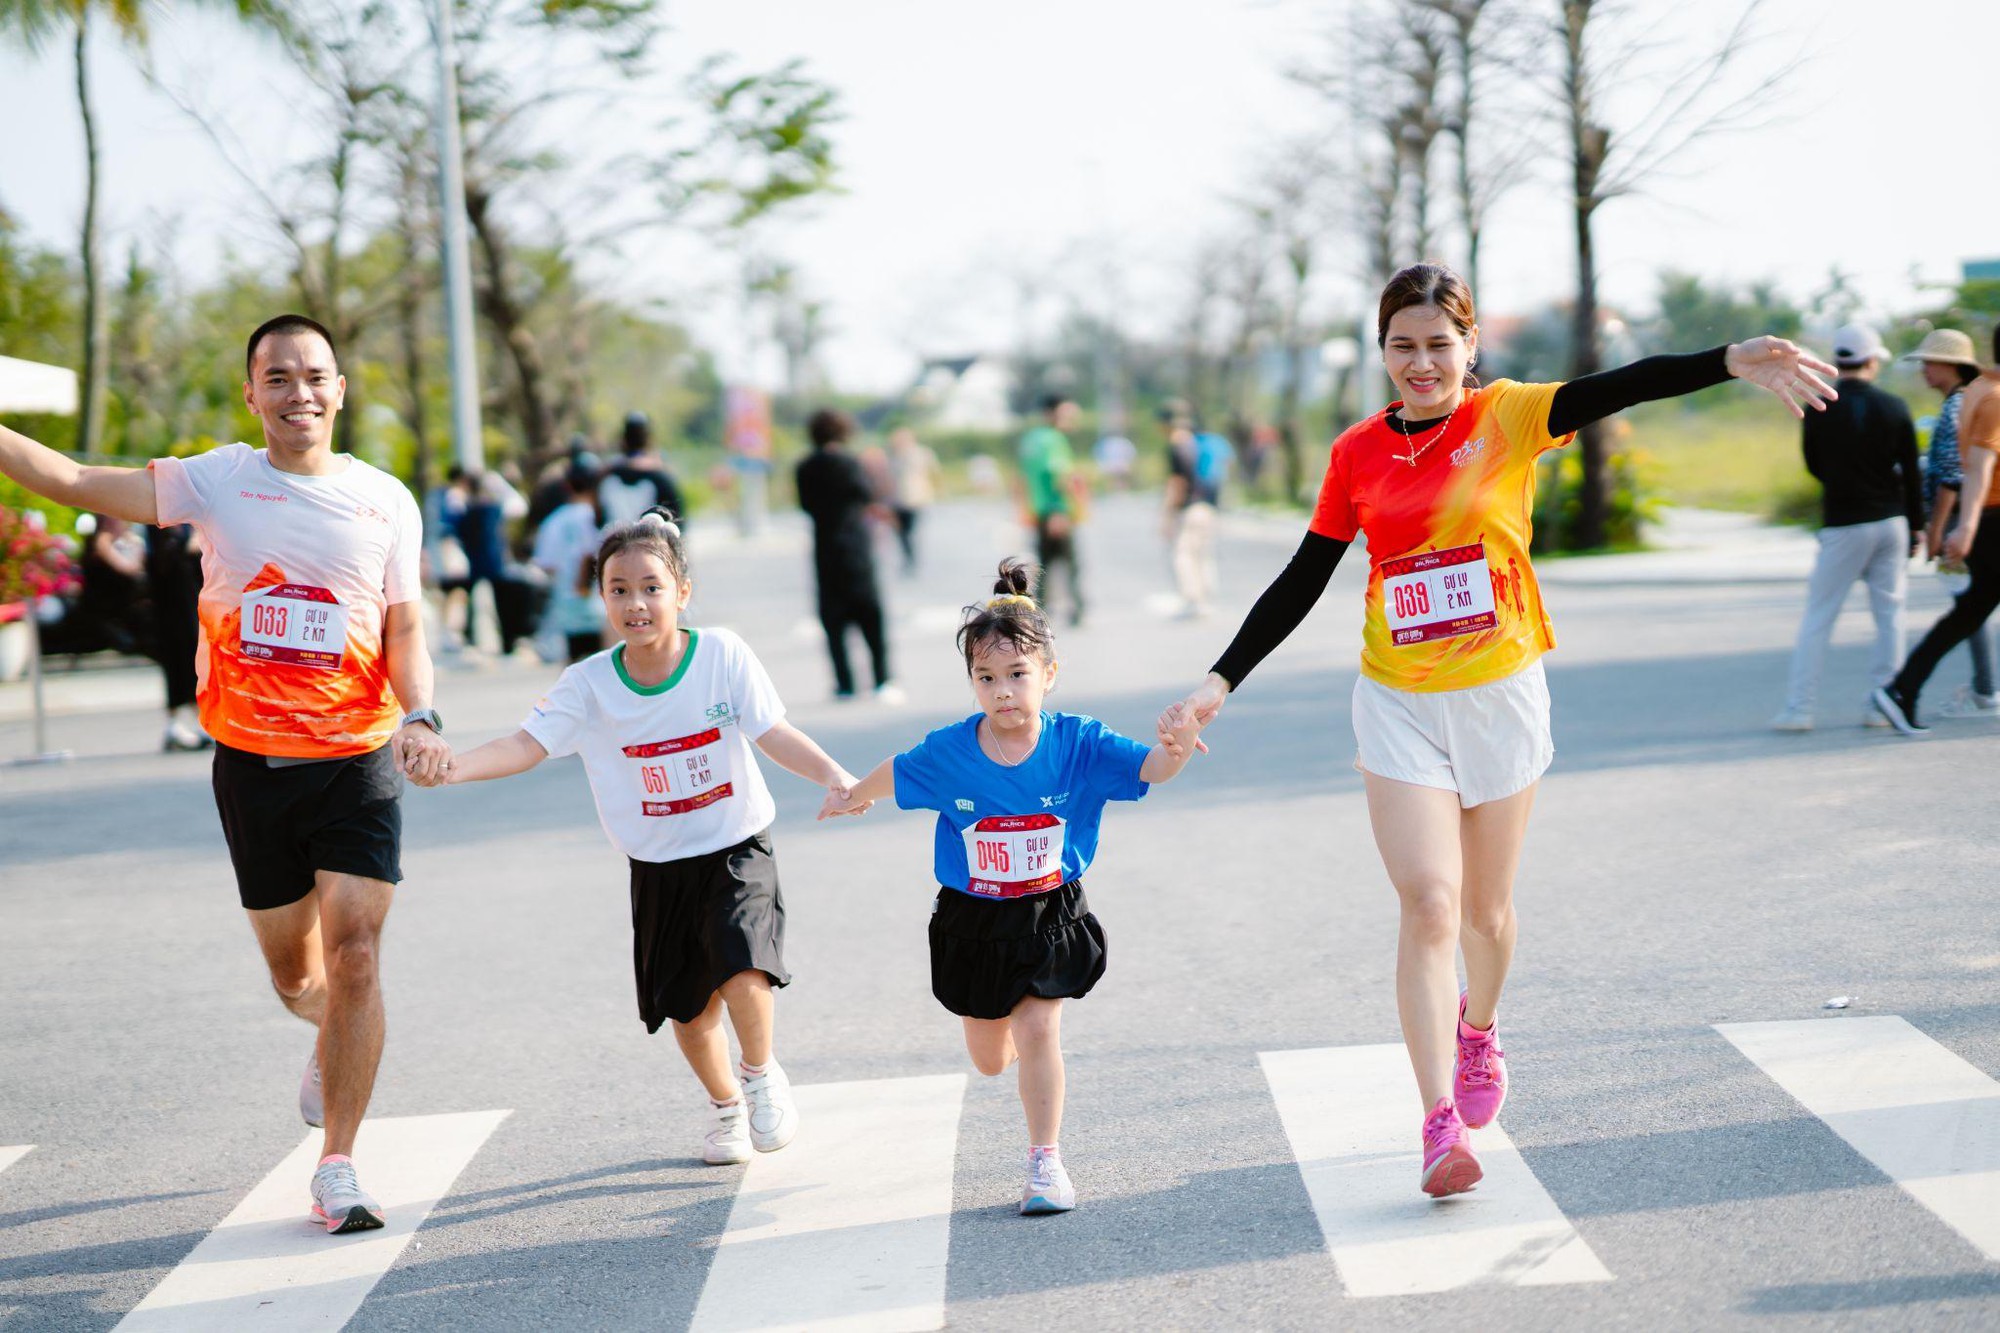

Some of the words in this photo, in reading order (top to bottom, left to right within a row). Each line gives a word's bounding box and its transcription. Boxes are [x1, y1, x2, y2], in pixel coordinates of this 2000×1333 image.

[1458, 572, 1467, 587] LY
[1394, 582, 1430, 618] 039
[1447, 594, 1455, 609] 2
[1457, 590, 1472, 607] KM
[253, 604, 287, 637] 033
[318, 611, 328, 624] LY
[303, 626, 309, 640] 2
[312, 627, 326, 642] KM
[699, 753, 708, 767] LY
[641, 766, 671, 793] 051
[690, 774, 698, 787] 2
[699, 769, 712, 784] KM
[1040, 836, 1048, 850] LY
[976, 840, 1010, 872] 045
[1027, 856, 1033, 870] 2
[1037, 853, 1047, 869] KM
